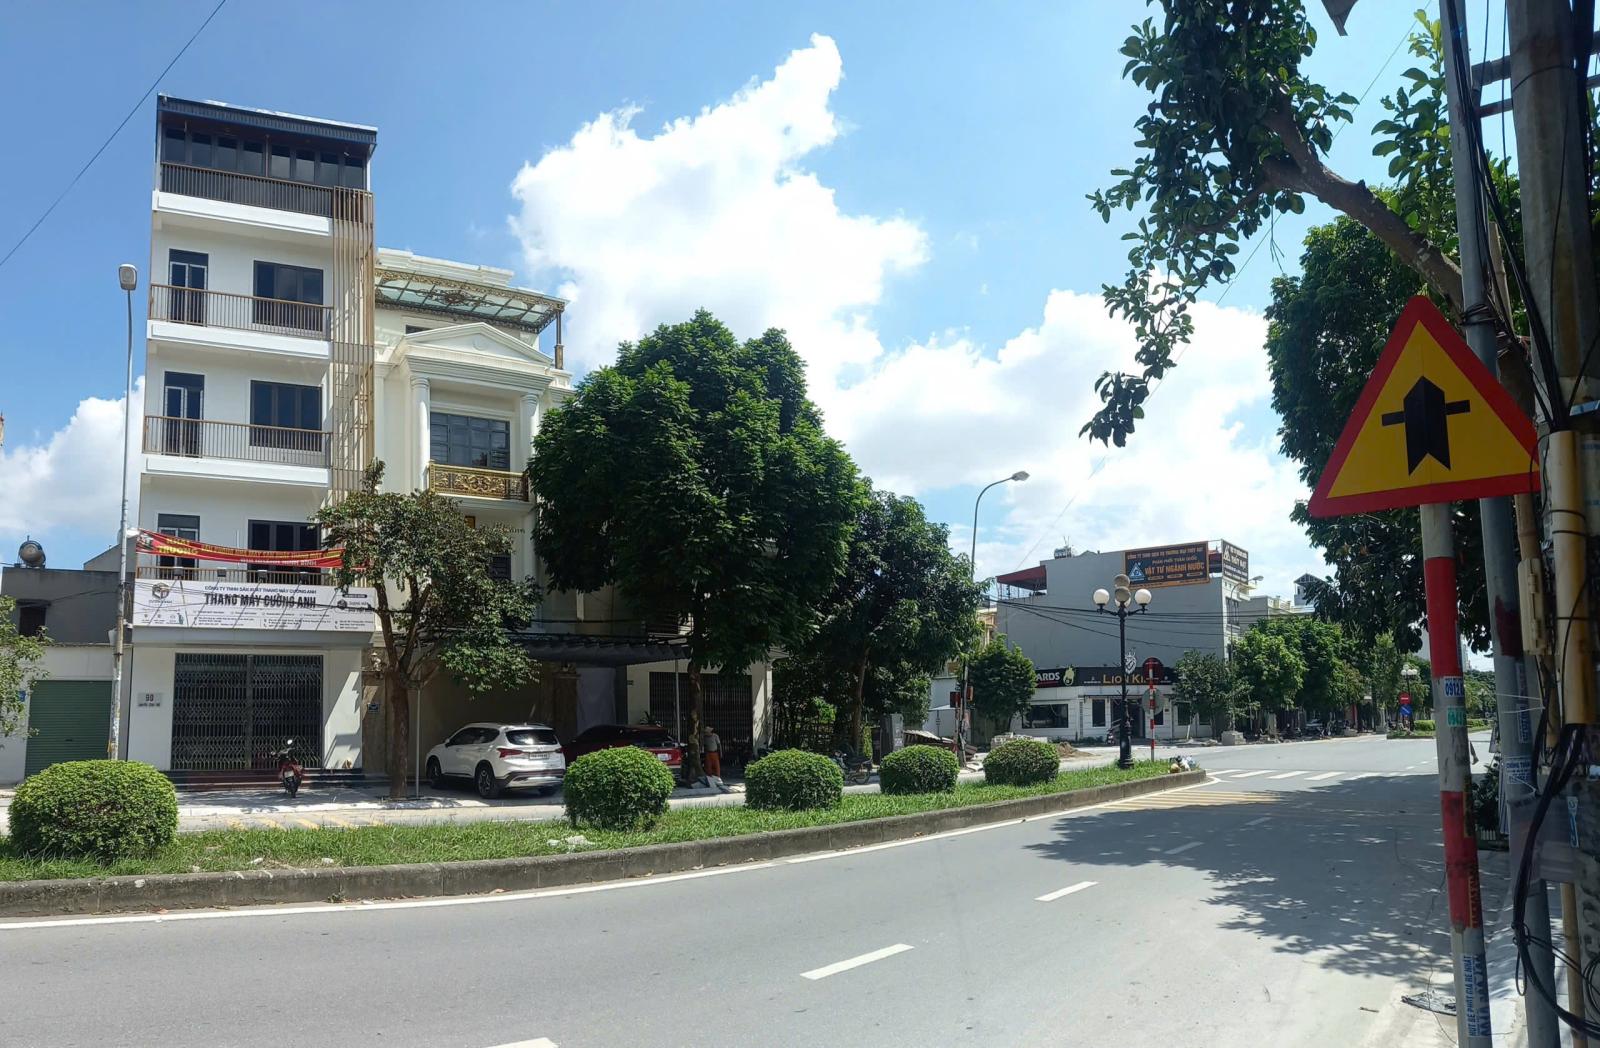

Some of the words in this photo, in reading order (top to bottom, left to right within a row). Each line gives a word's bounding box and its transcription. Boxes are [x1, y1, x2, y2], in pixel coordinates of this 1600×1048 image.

[205, 593, 237, 605] THANG
[240, 593, 260, 607] MÁY
[263, 593, 295, 608] CƯỜNG
[297, 596, 316, 608] ANH
